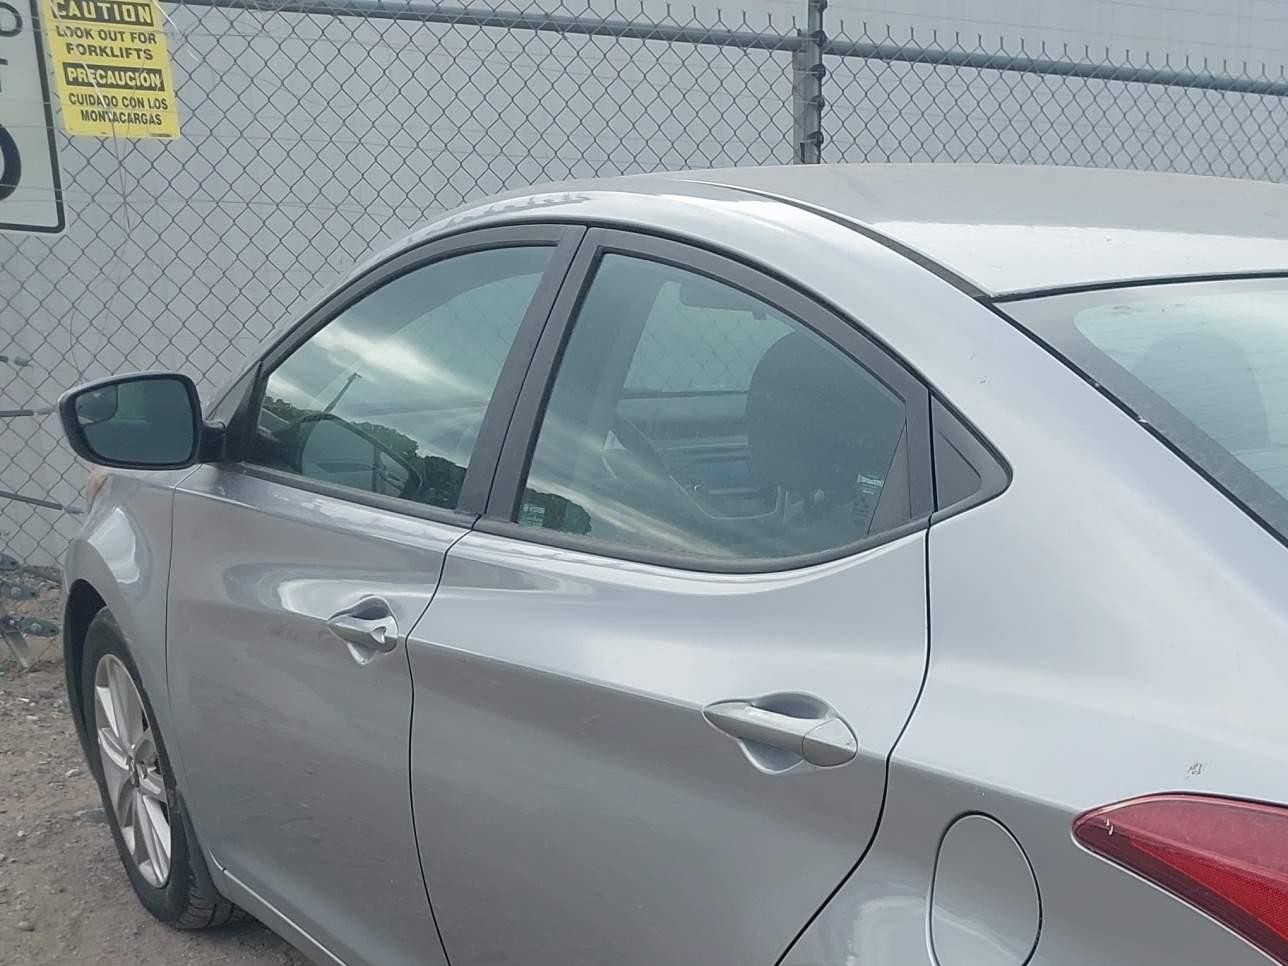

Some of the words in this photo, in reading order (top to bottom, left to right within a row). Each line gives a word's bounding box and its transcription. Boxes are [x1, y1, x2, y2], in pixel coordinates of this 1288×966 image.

[52, 0, 152, 24] CAUTION
[56, 25, 95, 40] LOOK
[98, 29, 126, 42] OUT
[130, 31, 157, 45] FOR
[66, 43, 154, 61] FORKLIFTS
[67, 66, 161, 88] PRECAUCIÓN
[69, 92, 118, 108] CUIDADO
[122, 95, 144, 109] CON
[148, 97, 169, 110] LOS
[80, 109, 162, 125] MONTACARGAS
